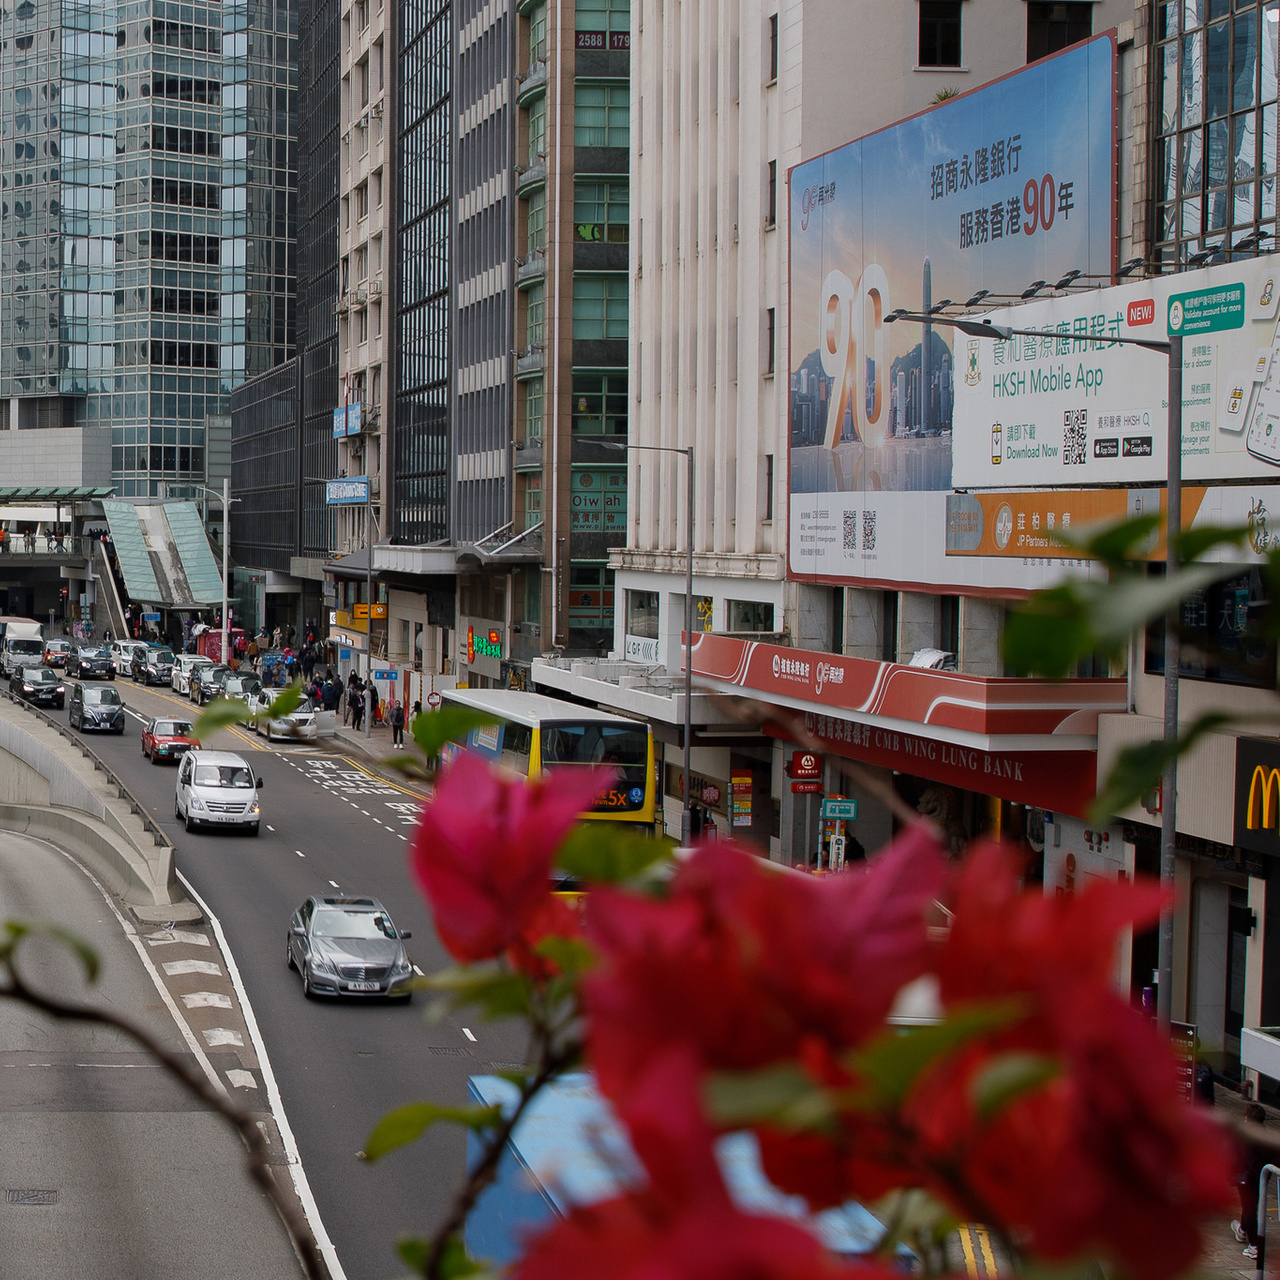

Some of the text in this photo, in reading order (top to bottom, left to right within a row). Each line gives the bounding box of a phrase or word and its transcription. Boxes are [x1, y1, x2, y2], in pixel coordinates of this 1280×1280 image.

[930, 134, 1022, 201] 招商永隆銀行
[1129, 305, 1152, 321] NEW!
[821, 262, 891, 450] 90
[1196, 359, 1212, 368] doctor
[992, 363, 1104, 398] HKSH Mobile App
[1123, 414, 1141, 426] HKSH
[1006, 443, 1059, 460] Download Now
[1016, 534, 1026, 547] JP
[1025, 534, 1049, 548] Partners
[874, 730, 900, 752] CMB
[904, 736, 937, 761] WING
[941, 745, 978, 770] LUNG
[983, 754, 1024, 782] BANK
